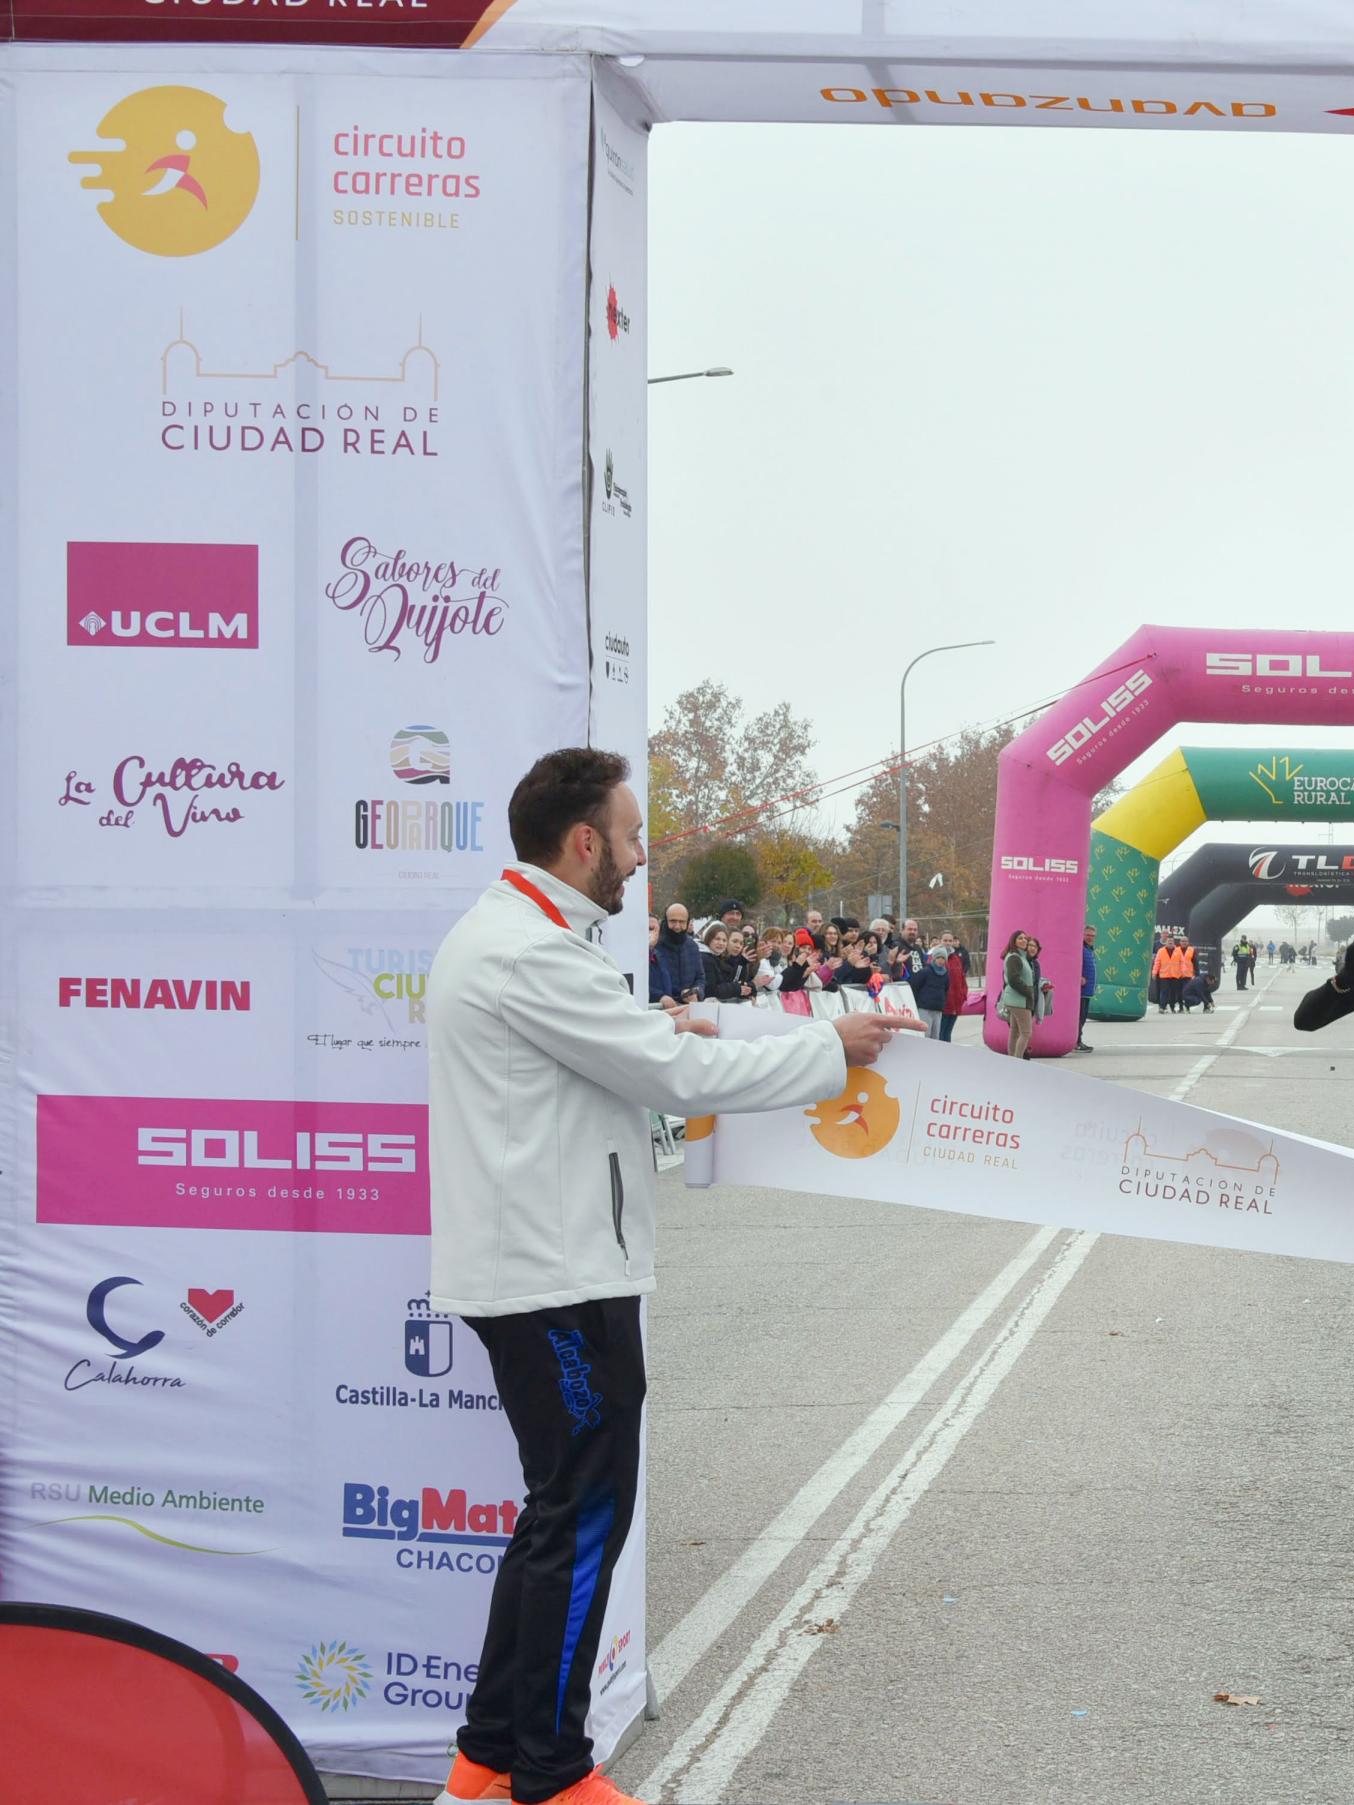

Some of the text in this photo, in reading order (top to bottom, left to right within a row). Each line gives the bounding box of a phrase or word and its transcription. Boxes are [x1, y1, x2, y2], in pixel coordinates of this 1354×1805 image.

[819, 86, 1277, 119] avanzando
[333, 125, 467, 159] circuito
[333, 169, 481, 199] carreras
[333, 209, 460, 229] SOSTENIBLE
[161, 401, 439, 424] DIPUTACIÓN DE
[161, 424, 439, 457] CIUDAD REAL
[325, 536, 500, 610] Sabores del
[110, 610, 249, 640] UCLM
[360, 583, 510, 664] Quijote
[1241, 684, 1318, 696] Seguros
[1045, 669, 1153, 767] SOLISS
[1076, 699, 1150, 764] Seguros desde 1933
[58, 755, 286, 807] La Cultura
[1293, 791, 1352, 805] RURAL
[99, 792, 246, 838] del Vino
[354, 799, 484, 853] GEOPARQUE
[1001, 856, 1078, 874] SOLISS
[347, 948, 434, 975] TURIS
[58, 976, 252, 1012] FENAVIN
[372, 972, 428, 1000] CIU
[407, 996, 427, 1025] R
[378, 1036, 422, 1051] siempre
[929, 1096, 1015, 1124] circuito
[138, 1127, 417, 1173] SOLISS
[926, 1123, 1020, 1151] carreras
[922, 1145, 1018, 1170] CIUDAD REAL
[175, 1181, 381, 1202] Seguros desde 1933
[1118, 1178, 1273, 1215] CIUDAD REAL
[1255, 1184, 1276, 1197] DE
[179, 1301, 246, 1338] corazón de corredor
[64, 1359, 187, 1392] Calahorra
[335, 1384, 440, 1411] Castilla-La
[30, 1481, 265, 1514] RSU Medio Ambiente
[342, 1482, 519, 1542] BigMat
[395, 1547, 502, 1575] CHACO
[421, 1654, 481, 1683] Ene
